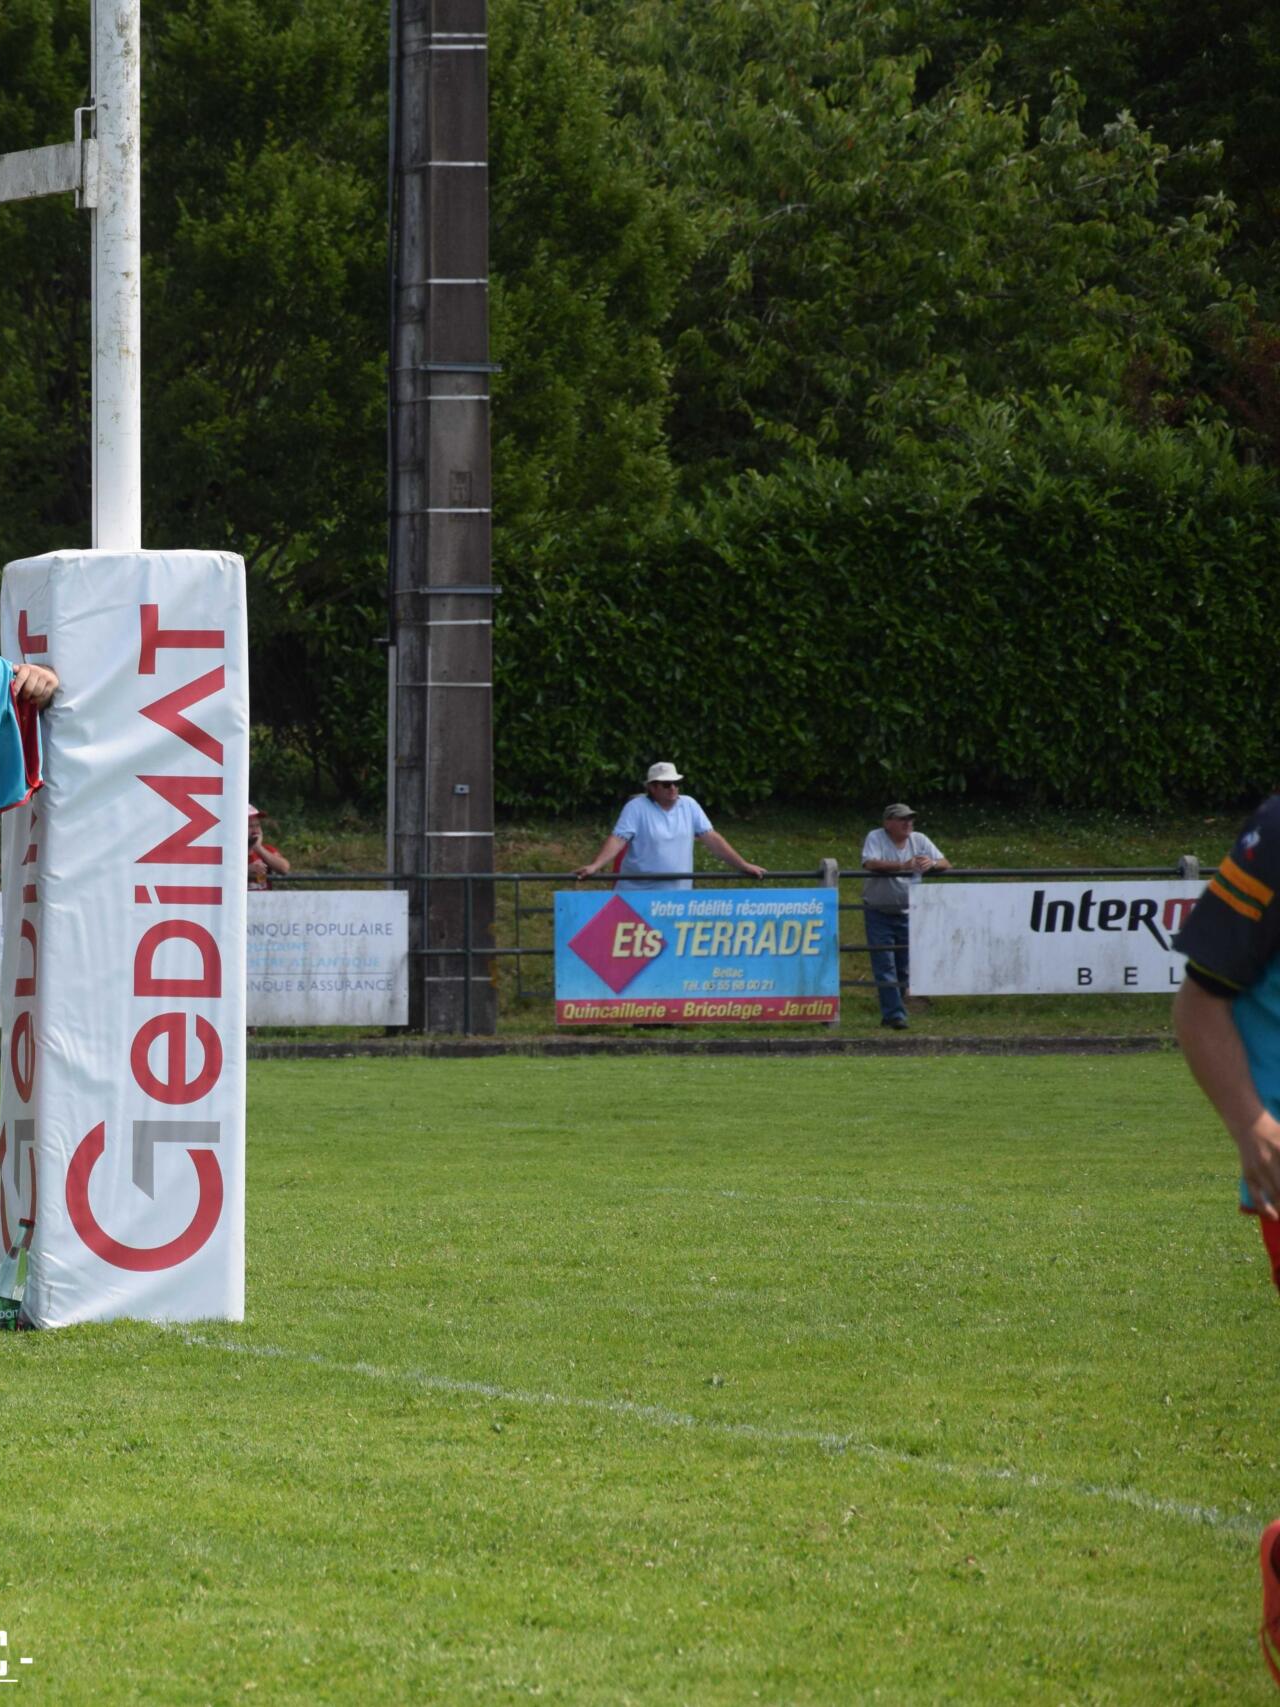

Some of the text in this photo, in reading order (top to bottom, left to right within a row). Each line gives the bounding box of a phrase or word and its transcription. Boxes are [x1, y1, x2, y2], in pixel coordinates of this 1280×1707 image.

[651, 899, 823, 918] Votre fidélité récompensée
[305, 922, 393, 936] POPULAIRE
[612, 919, 824, 958] Ets TERRADE
[297, 980, 305, 992] &
[310, 979, 393, 992] ASSURANCE
[563, 1002, 666, 1019] Quincaillerie
[682, 1000, 762, 1018] Bricolage
[778, 1000, 833, 1016] Jardin
